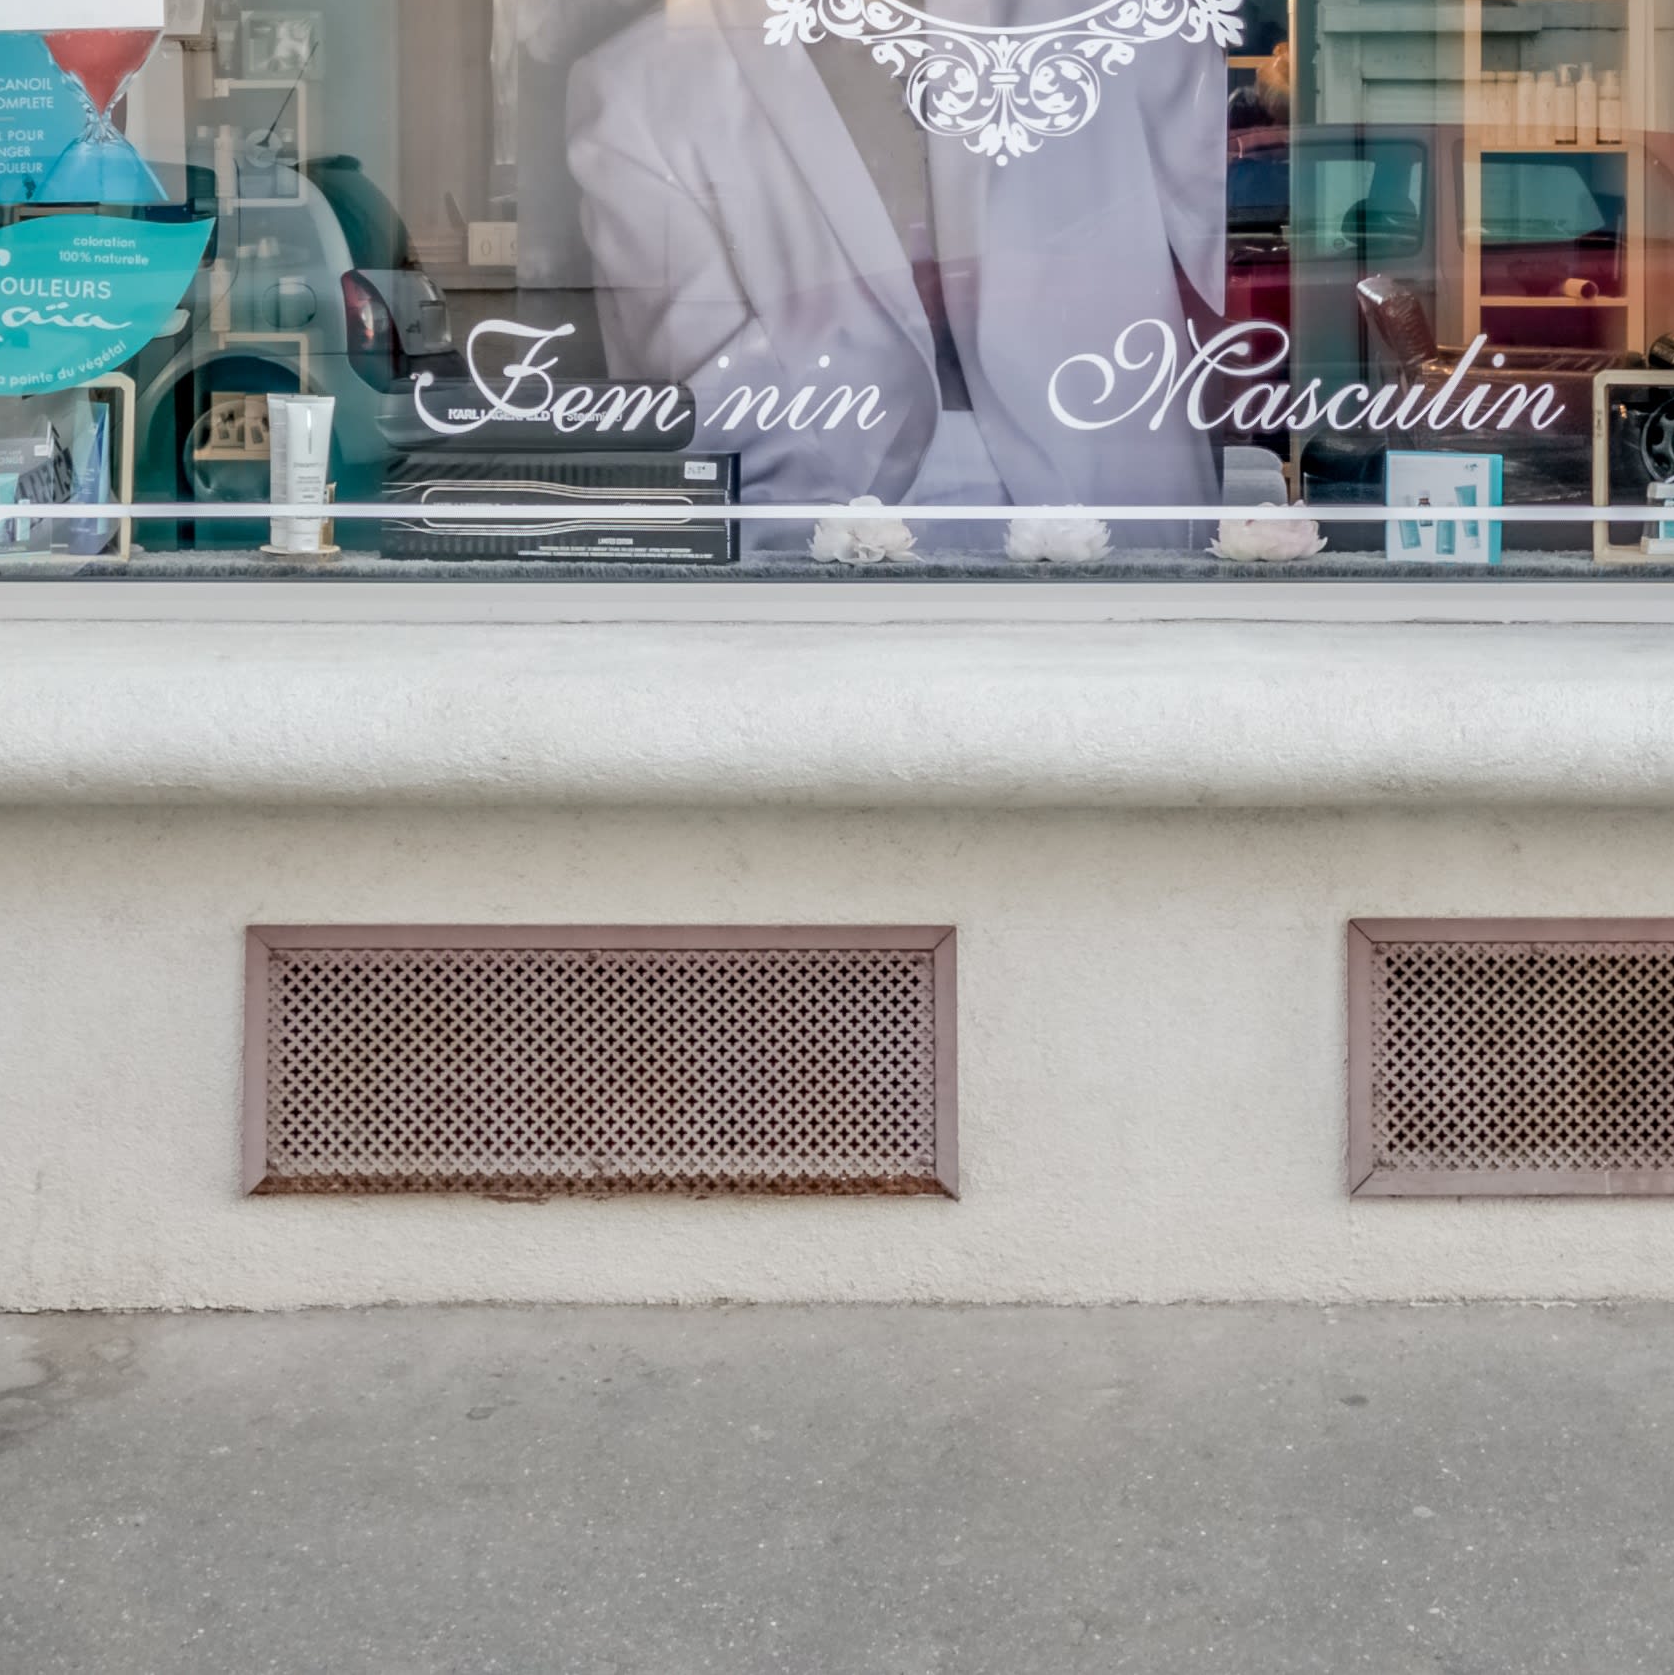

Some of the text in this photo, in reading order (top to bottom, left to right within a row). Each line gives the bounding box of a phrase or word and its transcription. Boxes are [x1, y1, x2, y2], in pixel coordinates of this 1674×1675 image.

[7, 129, 44, 142] POUR
[73, 235, 136, 248] coloration
[58, 250, 150, 266] 100% naturelle
[9, 372, 54, 388] pointe
[58, 366, 75, 381] du
[78, 340, 128, 373] végétal
[1047, 318, 1566, 431] Masculin
[447, 408, 480, 421] KARL
